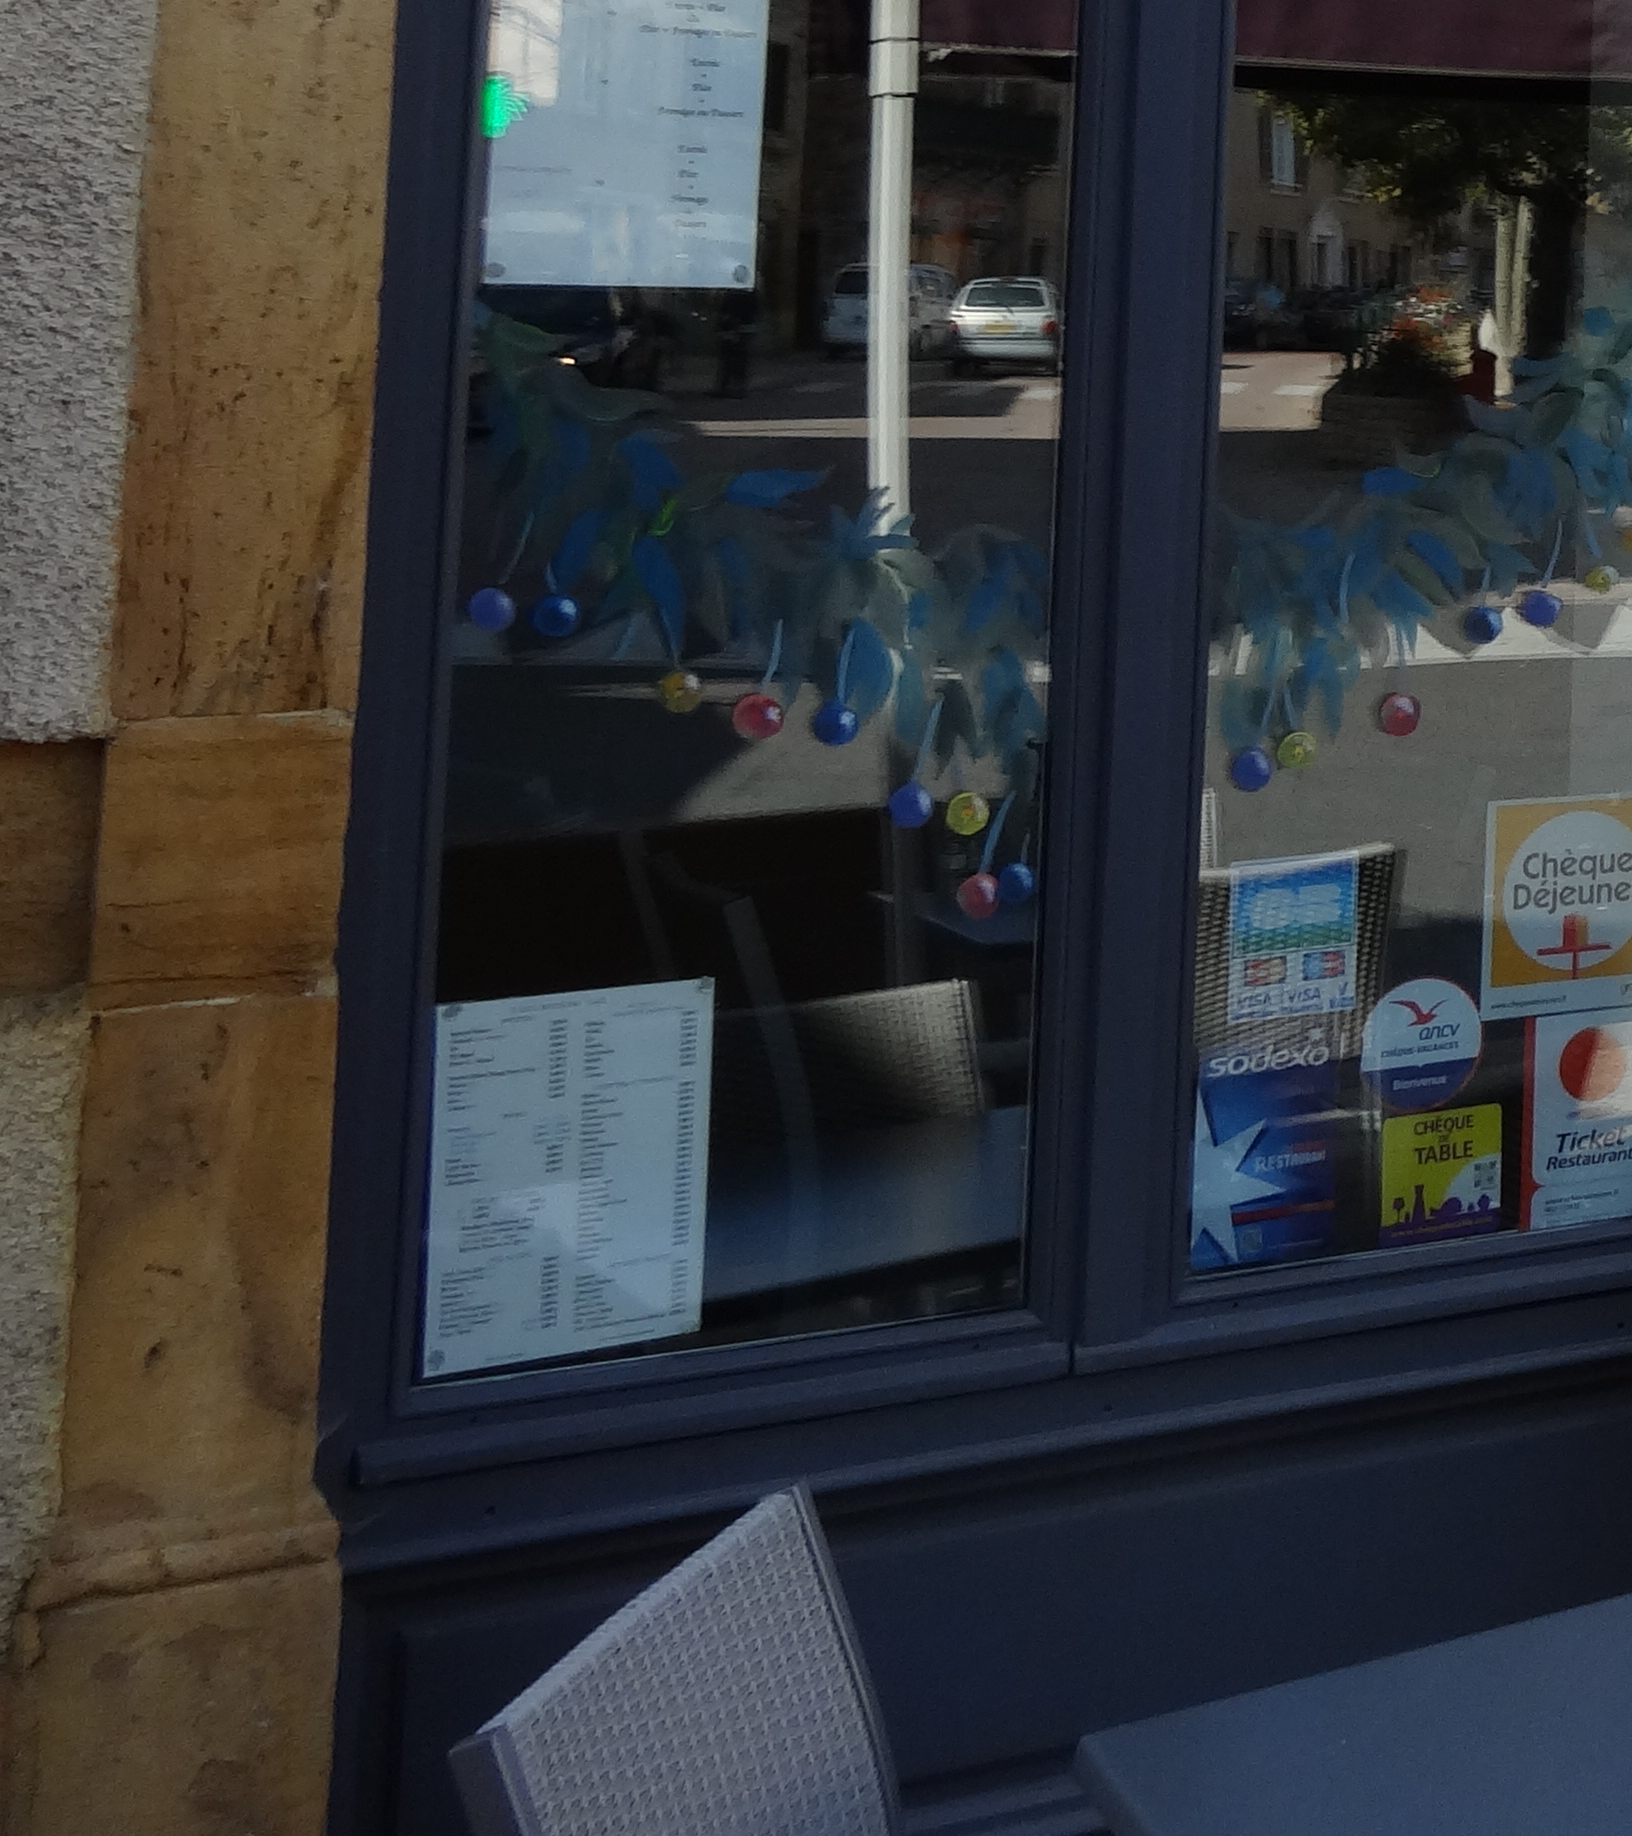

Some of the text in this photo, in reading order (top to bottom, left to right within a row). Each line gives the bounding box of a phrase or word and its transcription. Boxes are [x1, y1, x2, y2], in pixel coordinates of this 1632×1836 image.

[1419, 1024, 1461, 1041] ancv
[1207, 1044, 1330, 1078] sodexo
[1414, 1140, 1474, 1165] TABLE
[1556, 1126, 1626, 1153] Ticket
